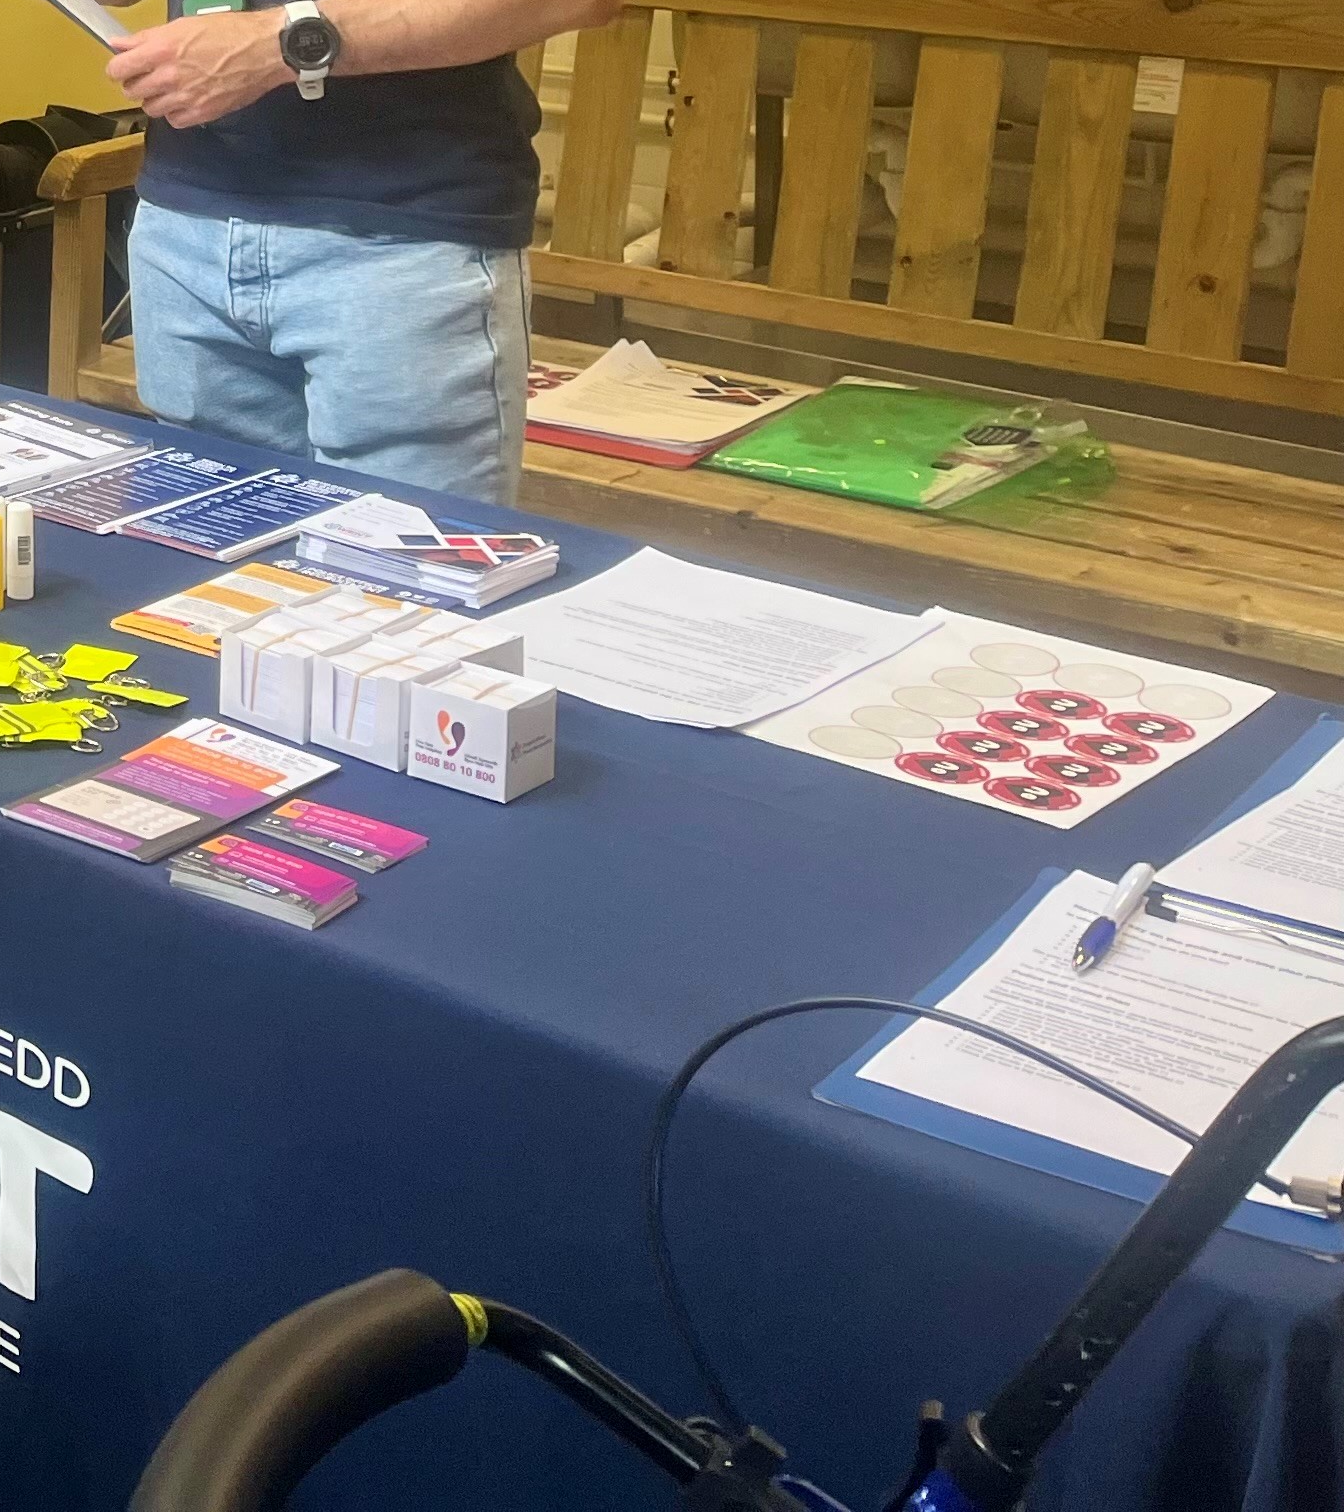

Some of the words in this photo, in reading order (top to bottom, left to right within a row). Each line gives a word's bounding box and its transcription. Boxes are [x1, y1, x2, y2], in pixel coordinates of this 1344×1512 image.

[415, 751, 441, 768] 0808
[443, 760, 457, 772] 80
[460, 765, 473, 777] 10
[475, 770, 497, 784] 800
